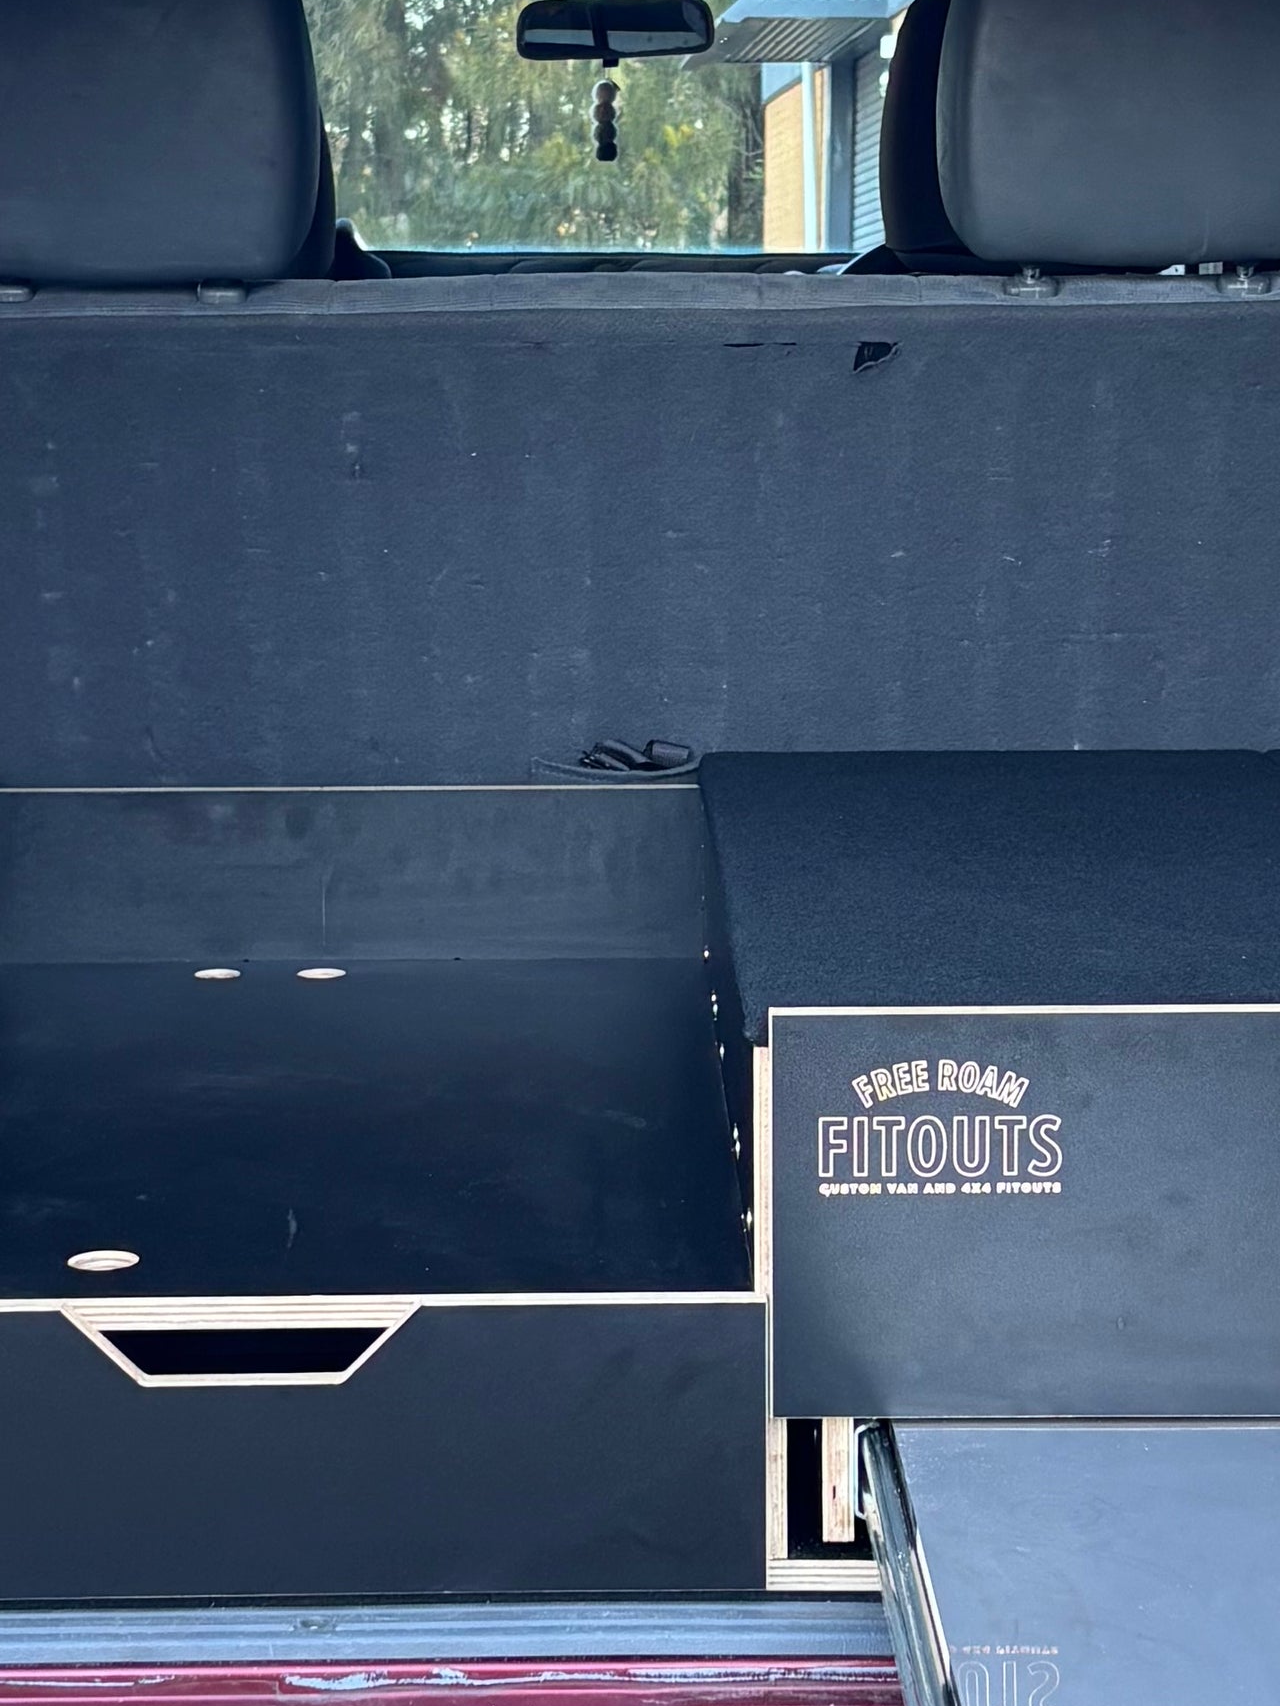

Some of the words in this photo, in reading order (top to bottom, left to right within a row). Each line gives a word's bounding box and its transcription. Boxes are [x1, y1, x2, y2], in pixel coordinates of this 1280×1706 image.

[852, 1059, 930, 1109] FREE
[937, 1058, 1030, 1109] ROAM
[817, 1113, 1063, 1178] FITOUTS
[818, 1182, 881, 1196] CUSTOM
[886, 1182, 919, 1195] VAN
[923, 1182, 957, 1195] AND
[960, 1182, 992, 1195] 4X4
[996, 1181, 1062, 1195] FITOUTS
